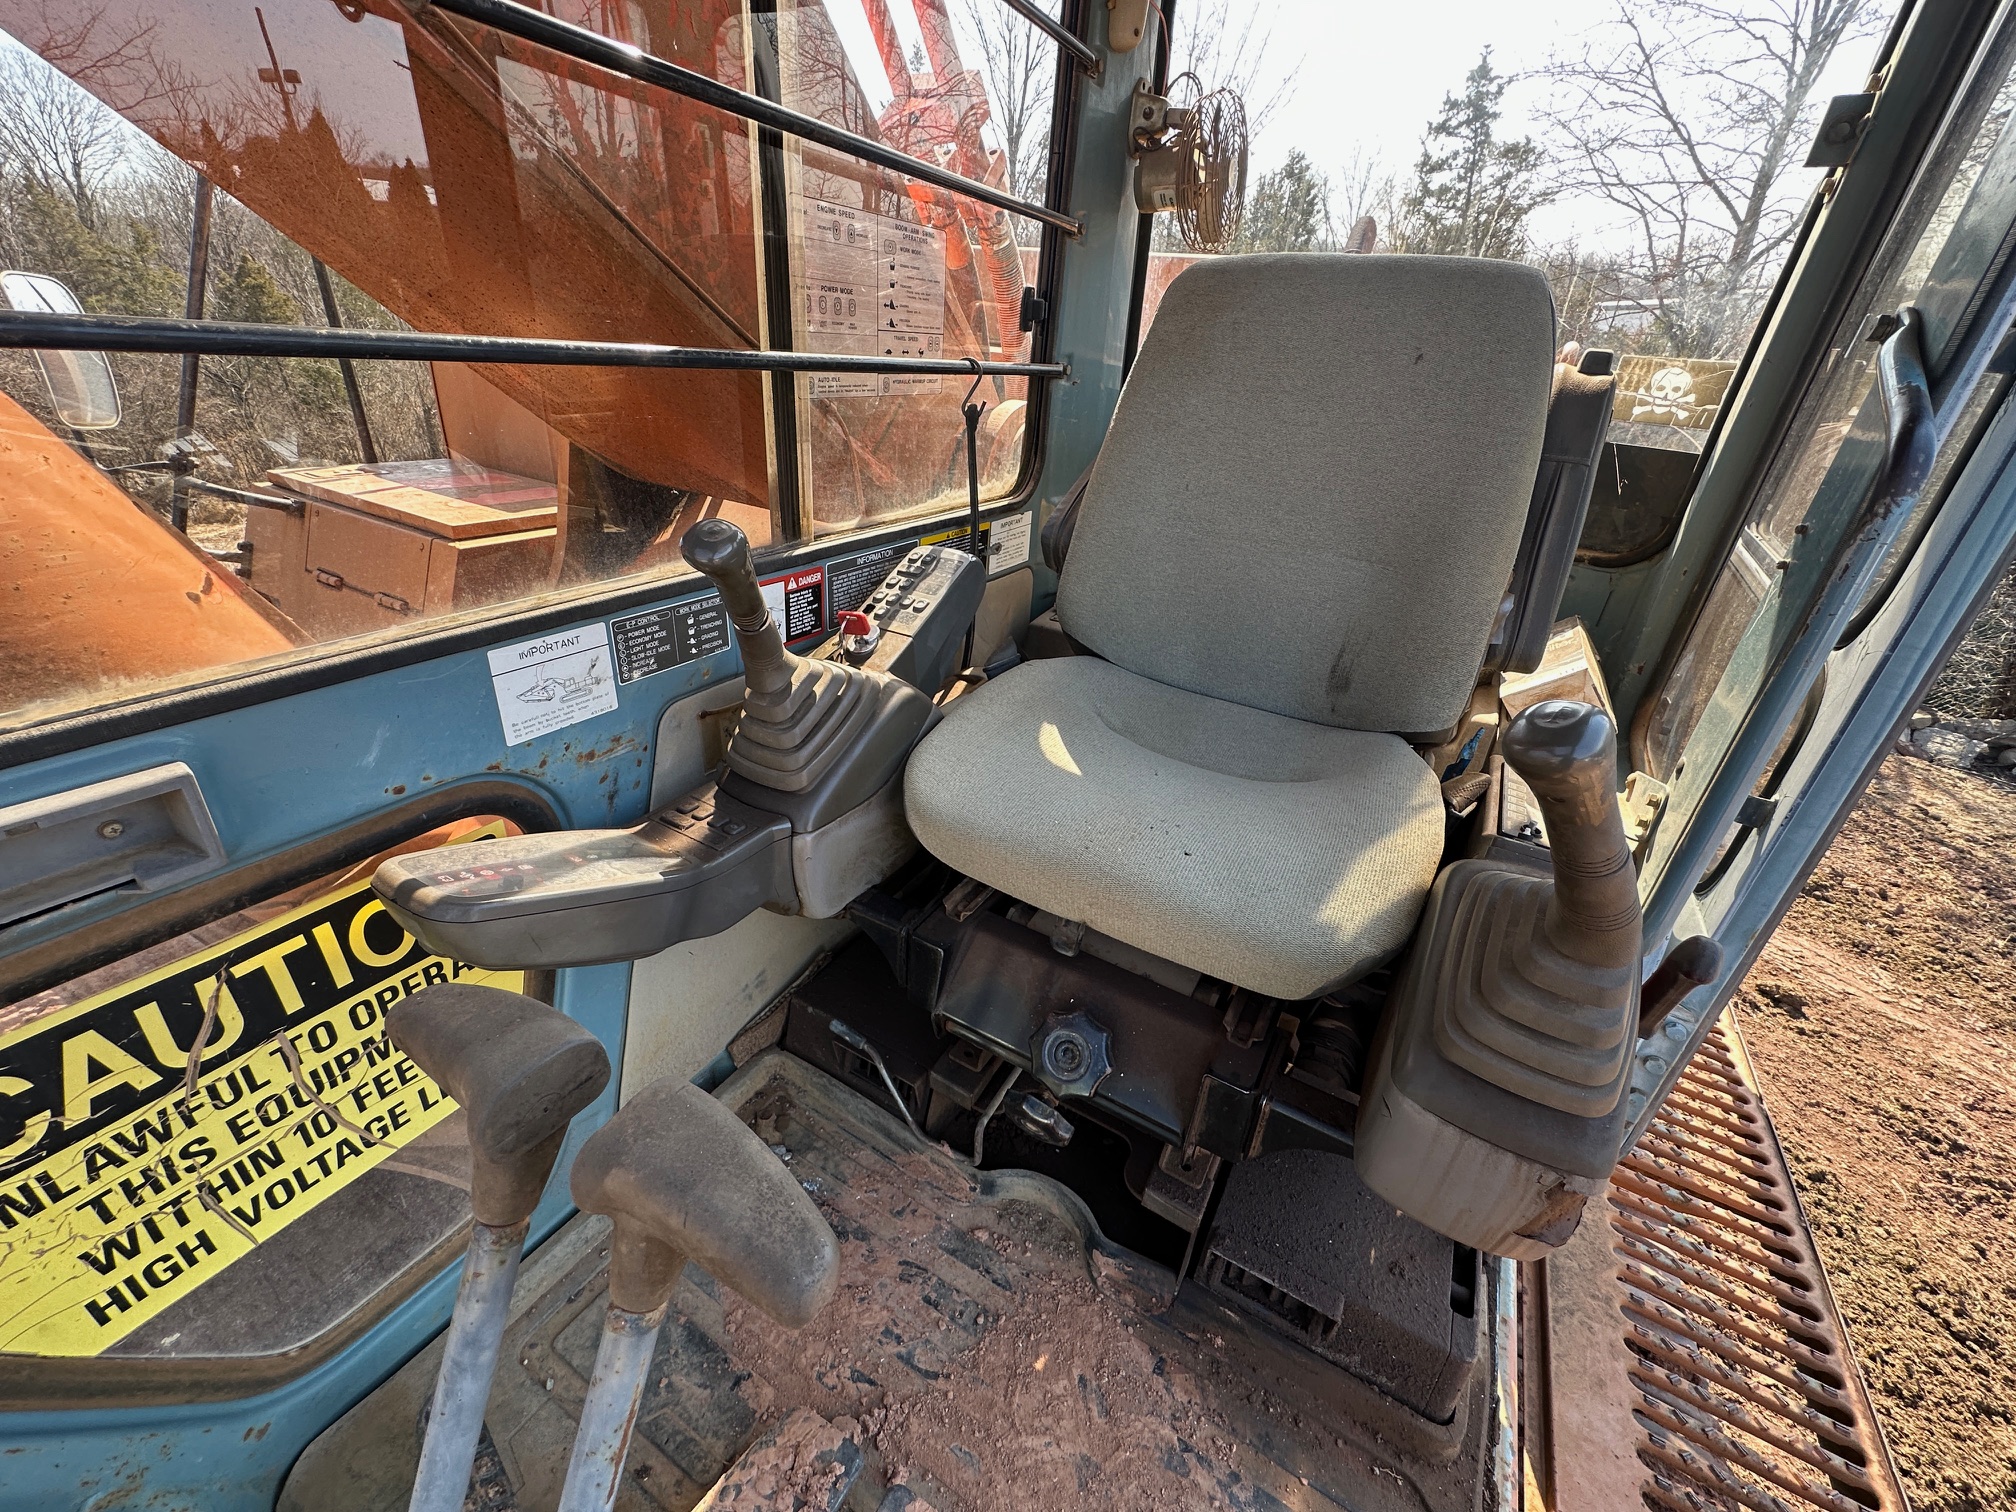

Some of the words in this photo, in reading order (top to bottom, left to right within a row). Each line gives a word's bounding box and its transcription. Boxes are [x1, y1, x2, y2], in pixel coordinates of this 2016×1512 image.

[816, 204, 836, 216] ENGINE
[838, 209, 856, 220] SPEED
[902, 232, 928, 244] OPERATIONS
[821, 284, 838, 293] POWER
[1000, 517, 1023, 528] IMPORTANT
[856, 549, 894, 565] INFORMATION
[798, 572, 821, 586] DANGER
[637, 614, 660, 625] CONTROL
[699, 611, 718, 621] GENERAL
[627, 628, 645, 638] POWER
[646, 624, 660, 634] MODE
[700, 620, 722, 630] TRENCHING
[629, 635, 652, 646] ECONOMY
[654, 630, 667, 639] MODE
[700, 631, 719, 640] GRADING
[518, 635, 580, 660] IMPORTANT
[630, 643, 644, 654] LIGHT
[646, 640, 660, 649] MODE
[702, 640, 723, 650] PRECISION
[631, 649, 657, 661] SLOW-IDLE
[658, 644, 671, 653] MODE
[632, 657, 655, 668] INCREASE
[0, 897, 417, 1162] CAUTIO
[0, 1063, 272, 1229] NLAWFUL
[269, 1020, 338, 1073] TO
[75, 1135, 217, 1225] THIS
[225, 1029, 400, 1145] EQUIPM
[77, 1139, 286, 1276] WITHIN
[292, 1102, 339, 1149] 10
[351, 1057, 419, 1113] FEE
[84, 1229, 218, 1327] HIGH
[230, 1100, 411, 1227] VOLTAGE
